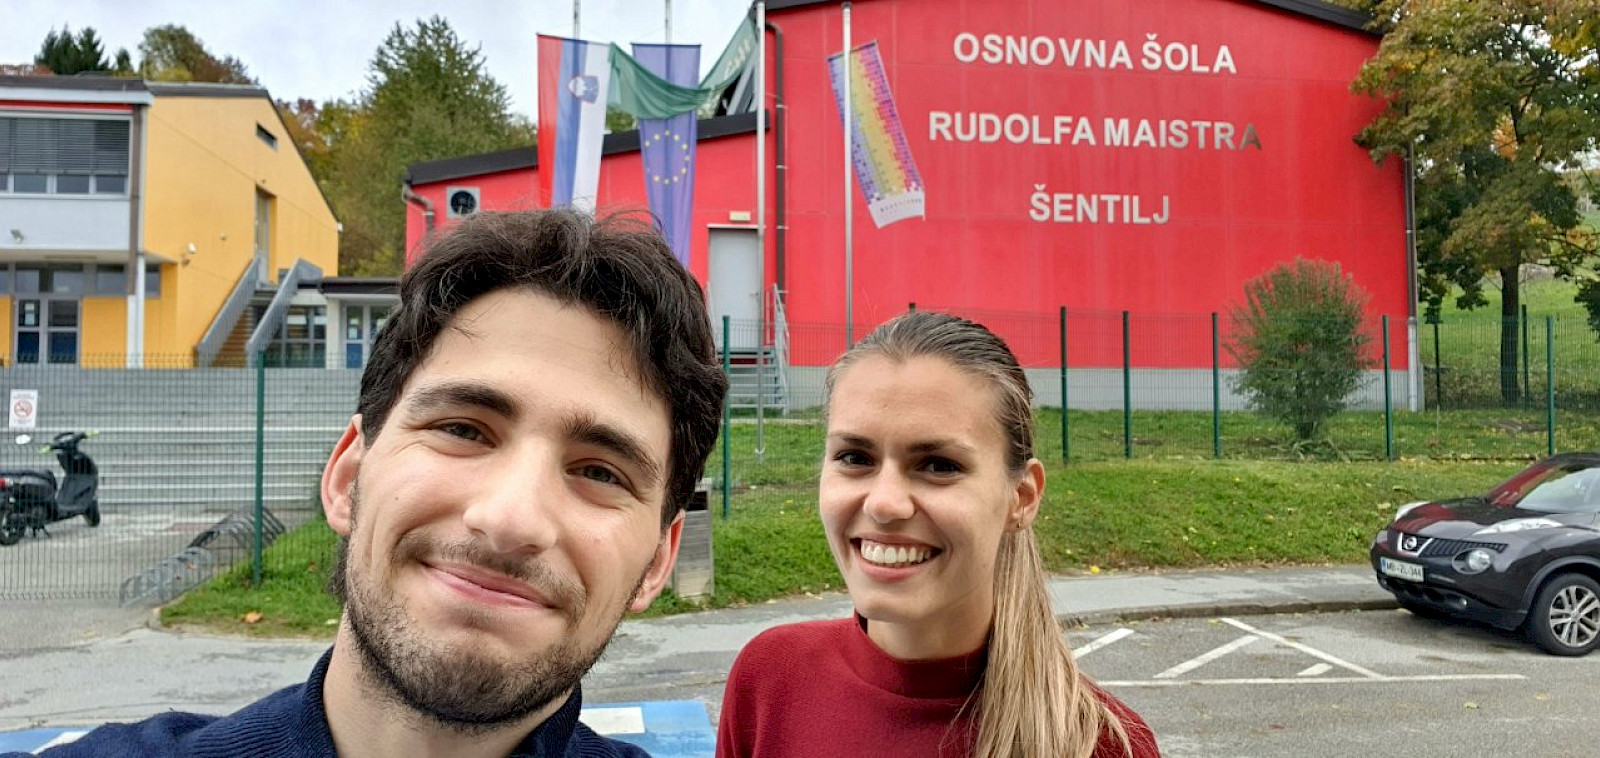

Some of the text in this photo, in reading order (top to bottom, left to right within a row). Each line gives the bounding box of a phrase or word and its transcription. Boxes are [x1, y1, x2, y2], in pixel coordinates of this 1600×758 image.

[953, 31, 1237, 75] OSNOVNA ŠOLA
[928, 111, 1263, 151] RUDOLFA MAISTRA
[1028, 183, 1170, 225] ŠENTILJ
